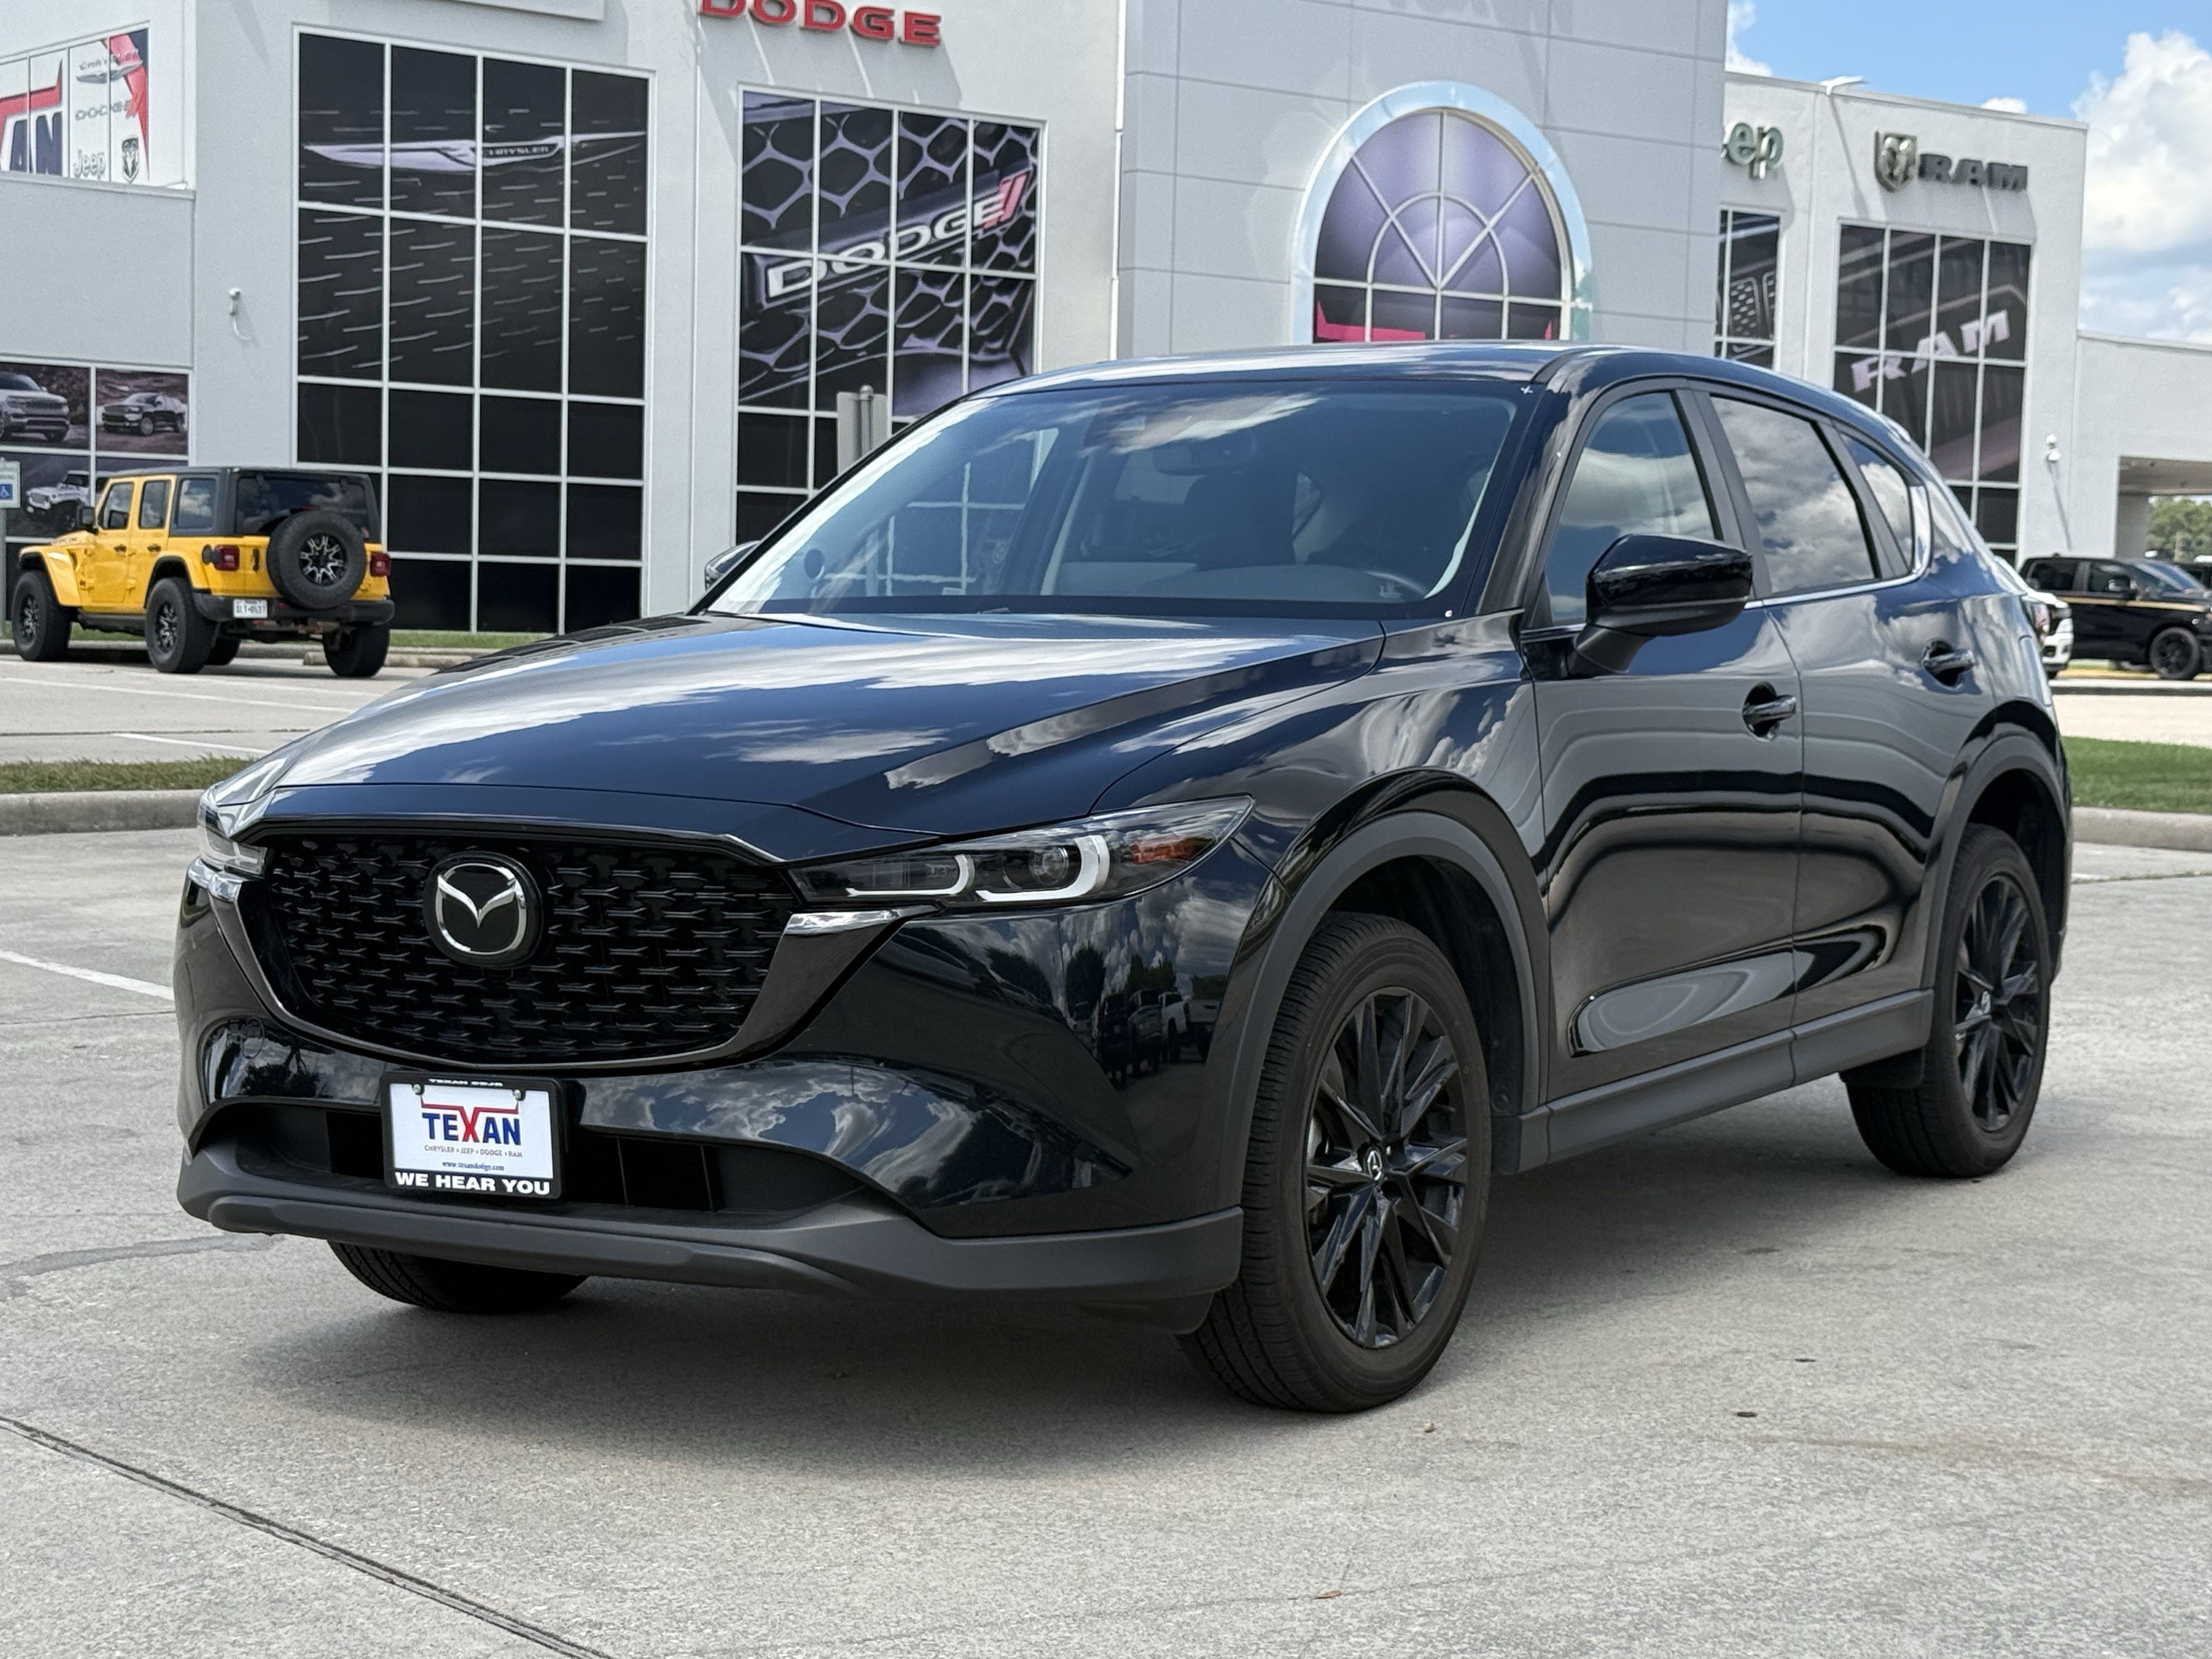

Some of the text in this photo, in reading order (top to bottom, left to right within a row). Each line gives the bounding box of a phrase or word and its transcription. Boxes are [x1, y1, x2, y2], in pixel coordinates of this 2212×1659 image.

[699, 0, 941, 46] DODGE
[0, 111, 63, 176] AN
[1722, 121, 1784, 180] ep
[72, 149, 106, 182] Jeep
[1918, 153, 2029, 192] RAM
[767, 192, 1006, 298] DODGE
[1850, 309, 2011, 393] RAM
[421, 1107, 522, 1146] TEXAN
[424, 1144, 454, 1153] CHRYSLER
[480, 1148, 503, 1157] DODGE
[395, 1171, 550, 1195] WE HEAR YOU
